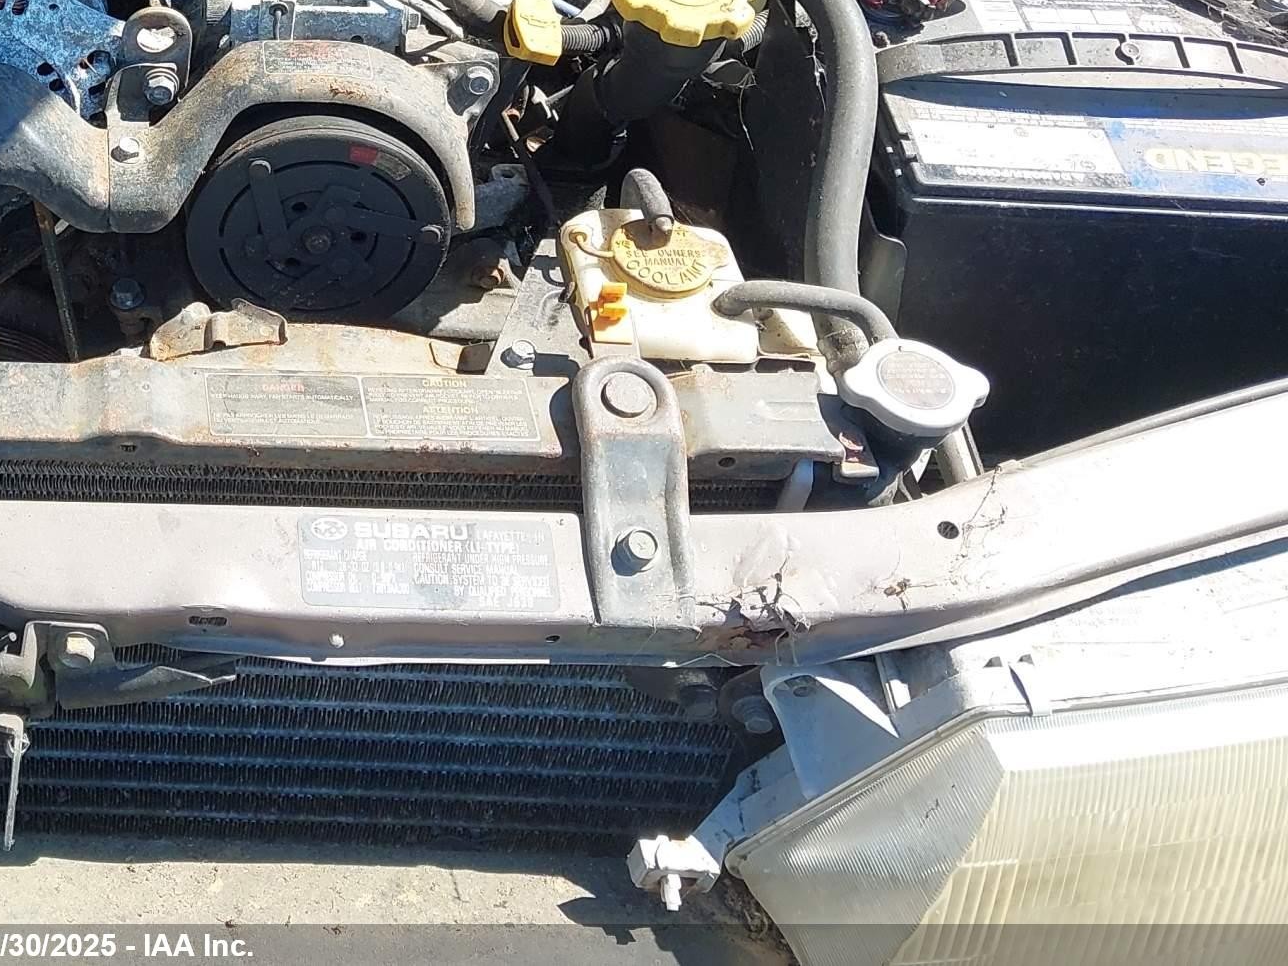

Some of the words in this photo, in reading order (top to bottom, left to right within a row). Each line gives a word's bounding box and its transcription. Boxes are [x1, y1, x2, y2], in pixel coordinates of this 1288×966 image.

[644, 257, 689, 267] MANUAL
[626, 259, 707, 286] COOLANT
[422, 380, 467, 388] CAUTION
[422, 405, 479, 415] ATTENTION
[354, 521, 469, 541] SUBARU
[356, 538, 377, 551] AIR
[383, 539, 462, 553] CONDITIONER
[413, 563, 448, 574] CONSULT
[451, 563, 482, 574] SERVICE
[414, 573, 449, 585] CAUTION
[453, 574, 484, 586] SYSTEM
[454, 585, 465, 597] BY
